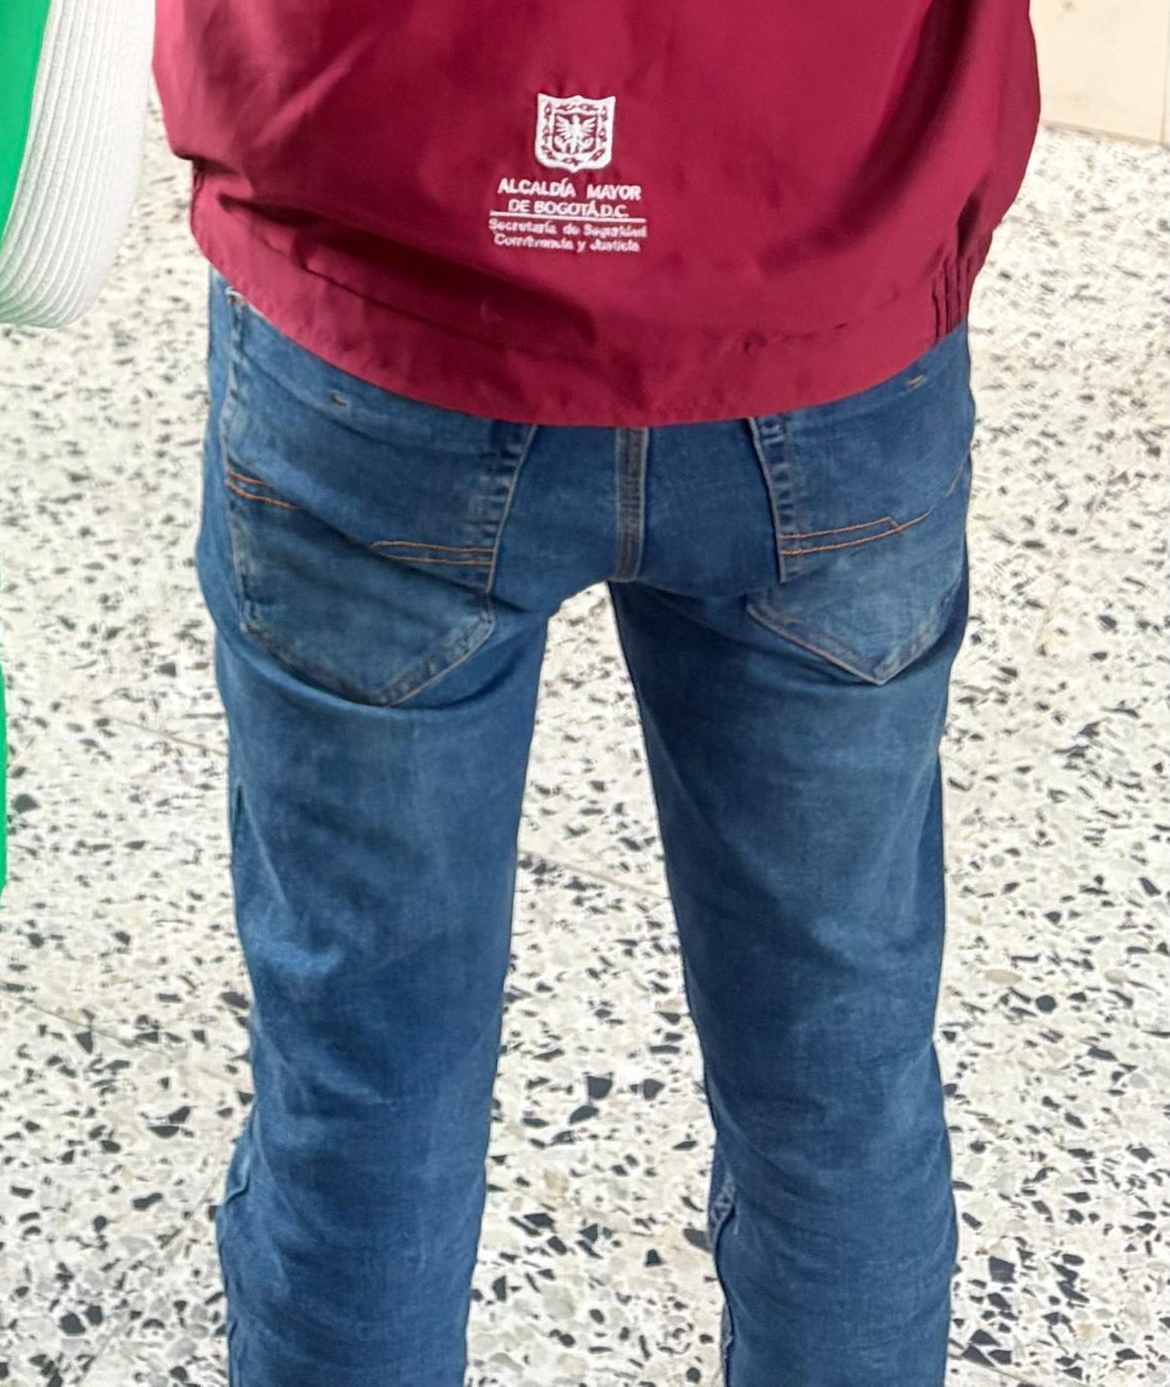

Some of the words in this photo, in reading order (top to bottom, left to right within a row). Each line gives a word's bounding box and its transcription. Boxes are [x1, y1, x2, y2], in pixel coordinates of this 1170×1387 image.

[497, 178, 576, 198] ALCALDÍA
[587, 184, 641, 200] MAYOR
[508, 199, 531, 212] DE
[577, 241, 586, 253] y
